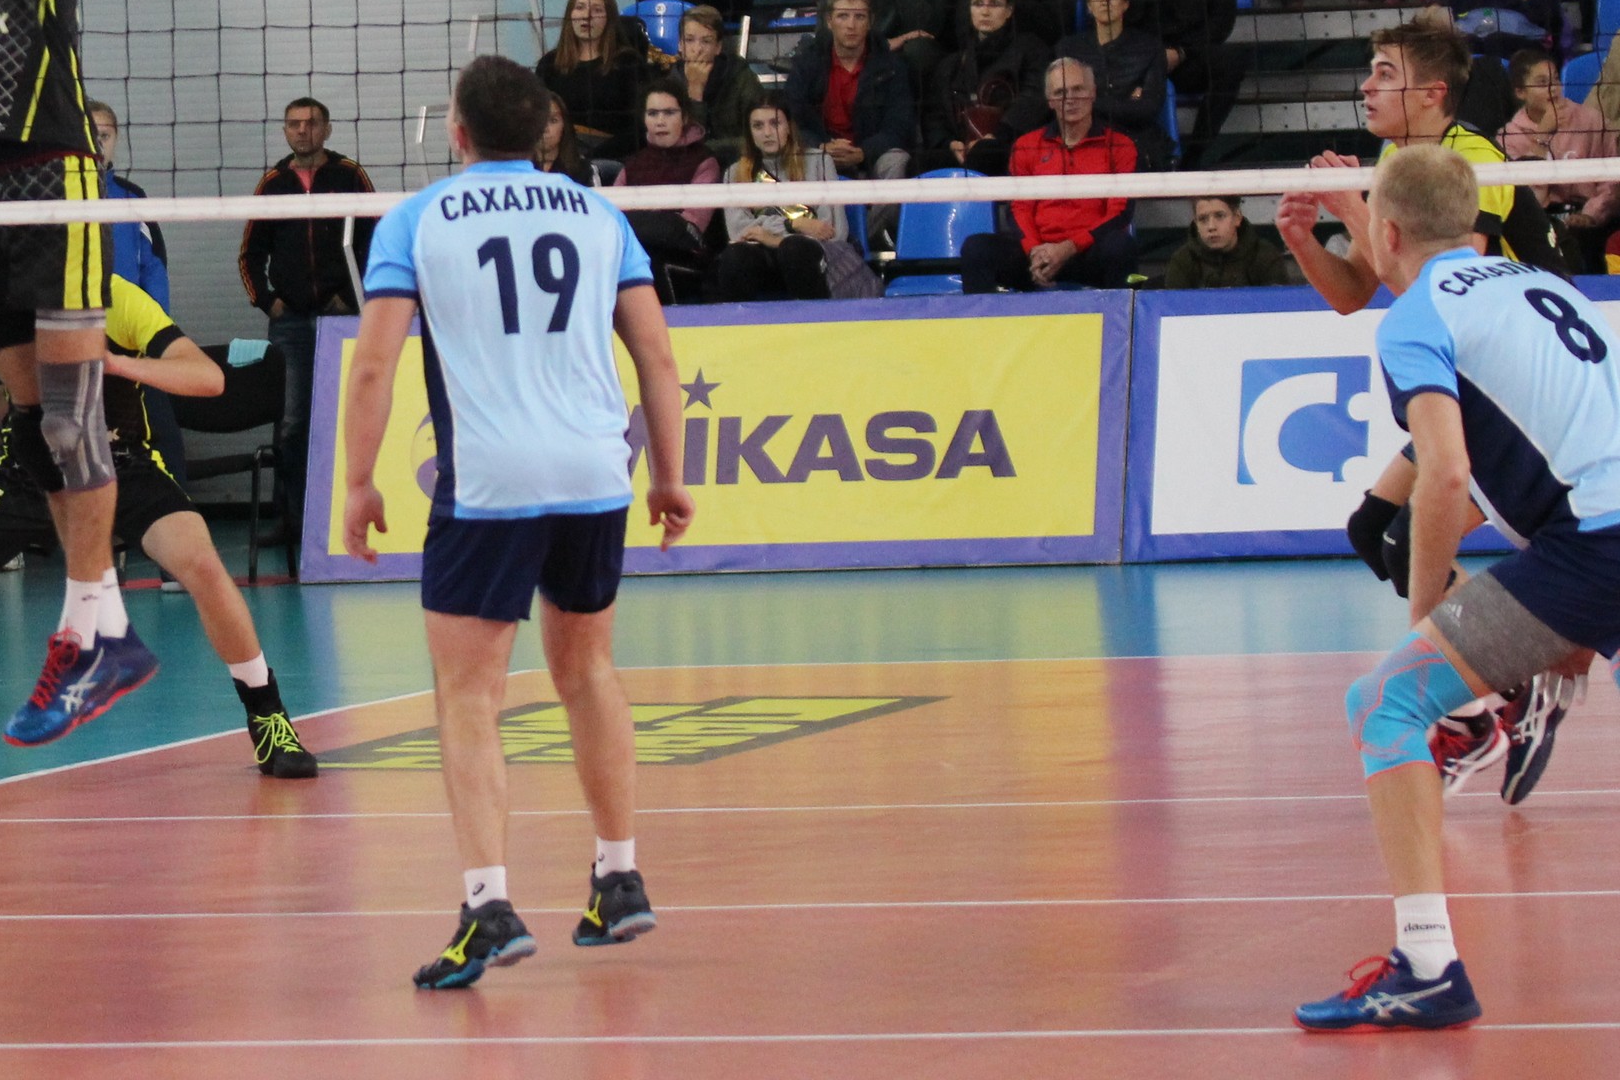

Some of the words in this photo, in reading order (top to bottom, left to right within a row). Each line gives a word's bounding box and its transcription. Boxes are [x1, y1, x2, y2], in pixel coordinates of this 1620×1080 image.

[440, 185, 589, 221] САХАЛИН
[477, 232, 580, 335] 19
[1523, 287, 1598, 364] 8
